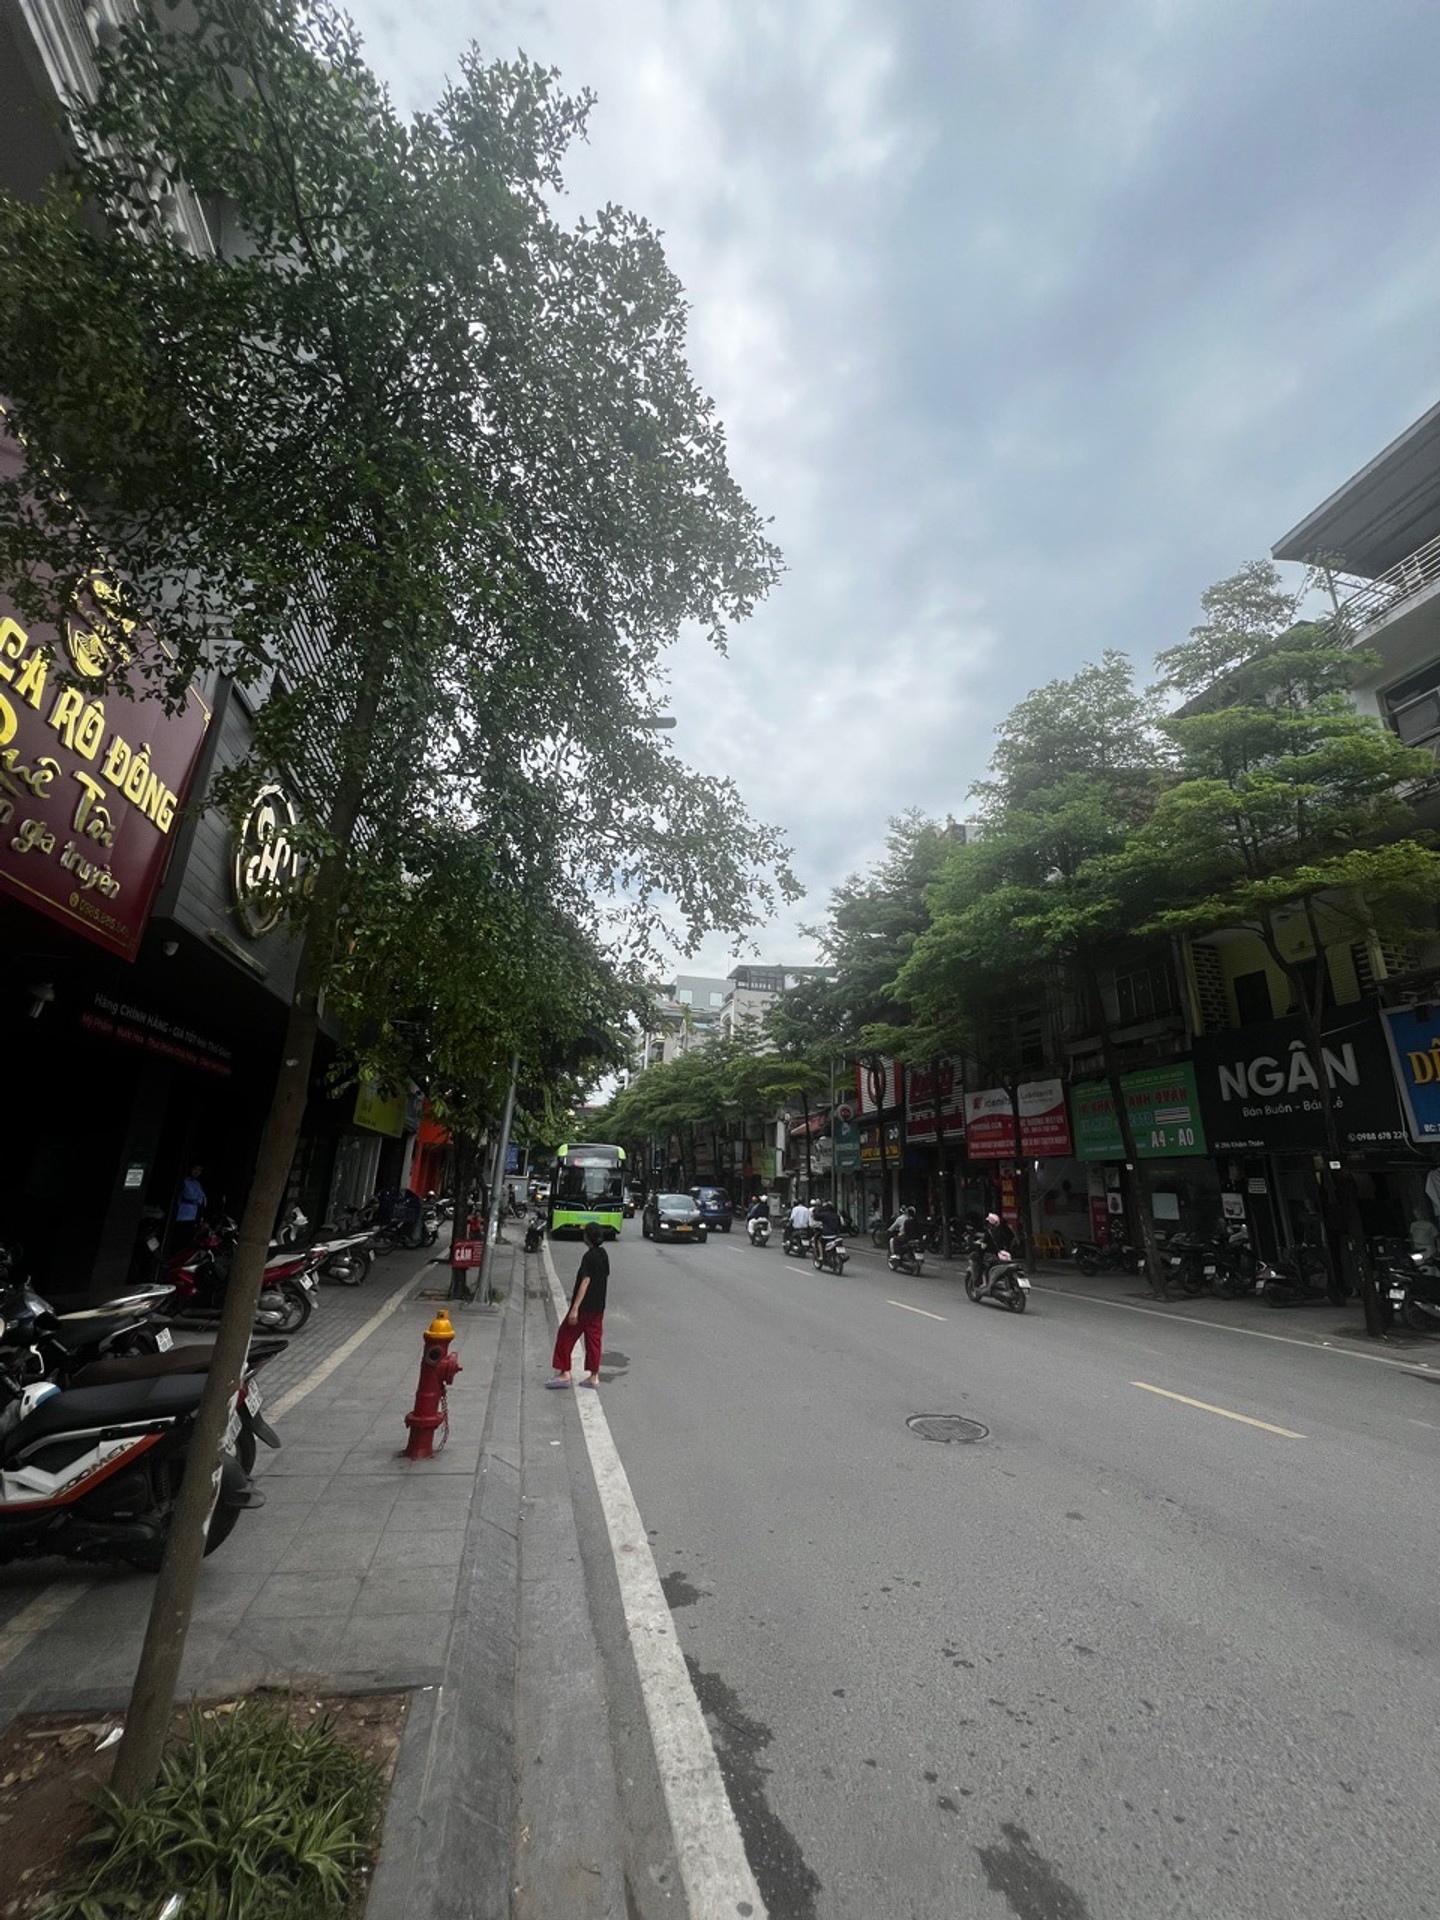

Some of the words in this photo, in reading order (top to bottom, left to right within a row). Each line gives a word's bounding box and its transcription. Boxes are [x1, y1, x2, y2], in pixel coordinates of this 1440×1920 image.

[48, 684, 106, 760] RÔ
[101, 735, 178, 834] ĐỒNG
[1217, 1039, 1360, 1101] NGÂN
